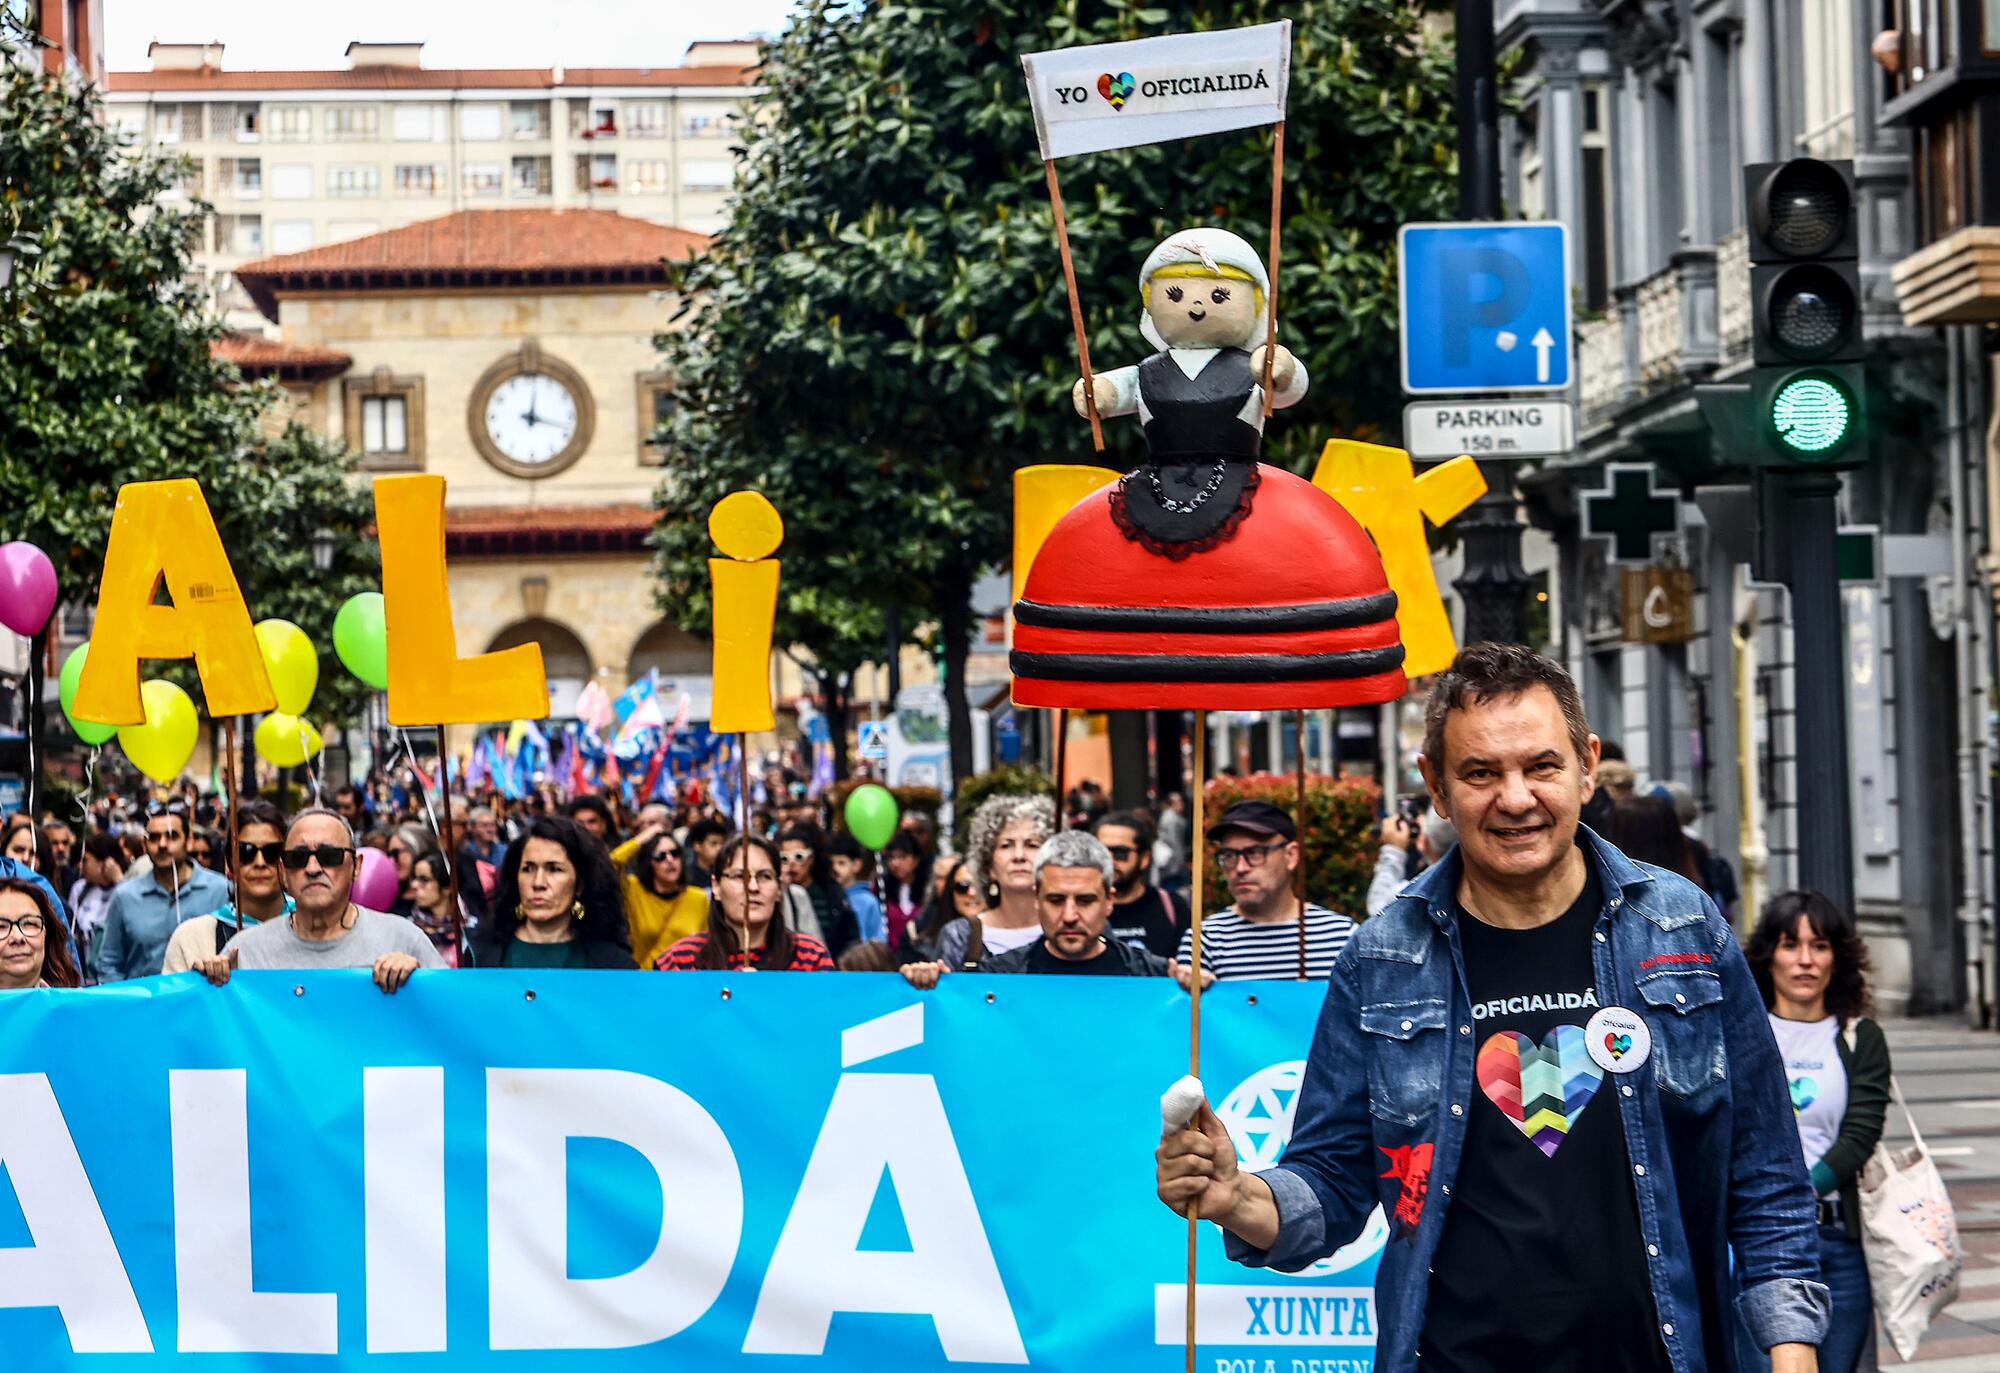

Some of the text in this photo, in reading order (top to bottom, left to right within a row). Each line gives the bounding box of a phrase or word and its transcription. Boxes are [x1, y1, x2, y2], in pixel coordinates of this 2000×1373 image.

[1055, 69, 1270, 104] YO OFICIALIDÁ
[1439, 247, 1531, 369] P
[1436, 408, 1543, 428] PARKING
[1461, 436, 1493, 450] 150
[1471, 988, 1600, 1020] OFICIALIDÁ
[1246, 1297, 1373, 1336] XUNTA
[1291, 1359, 1374, 1373] DEFEN
